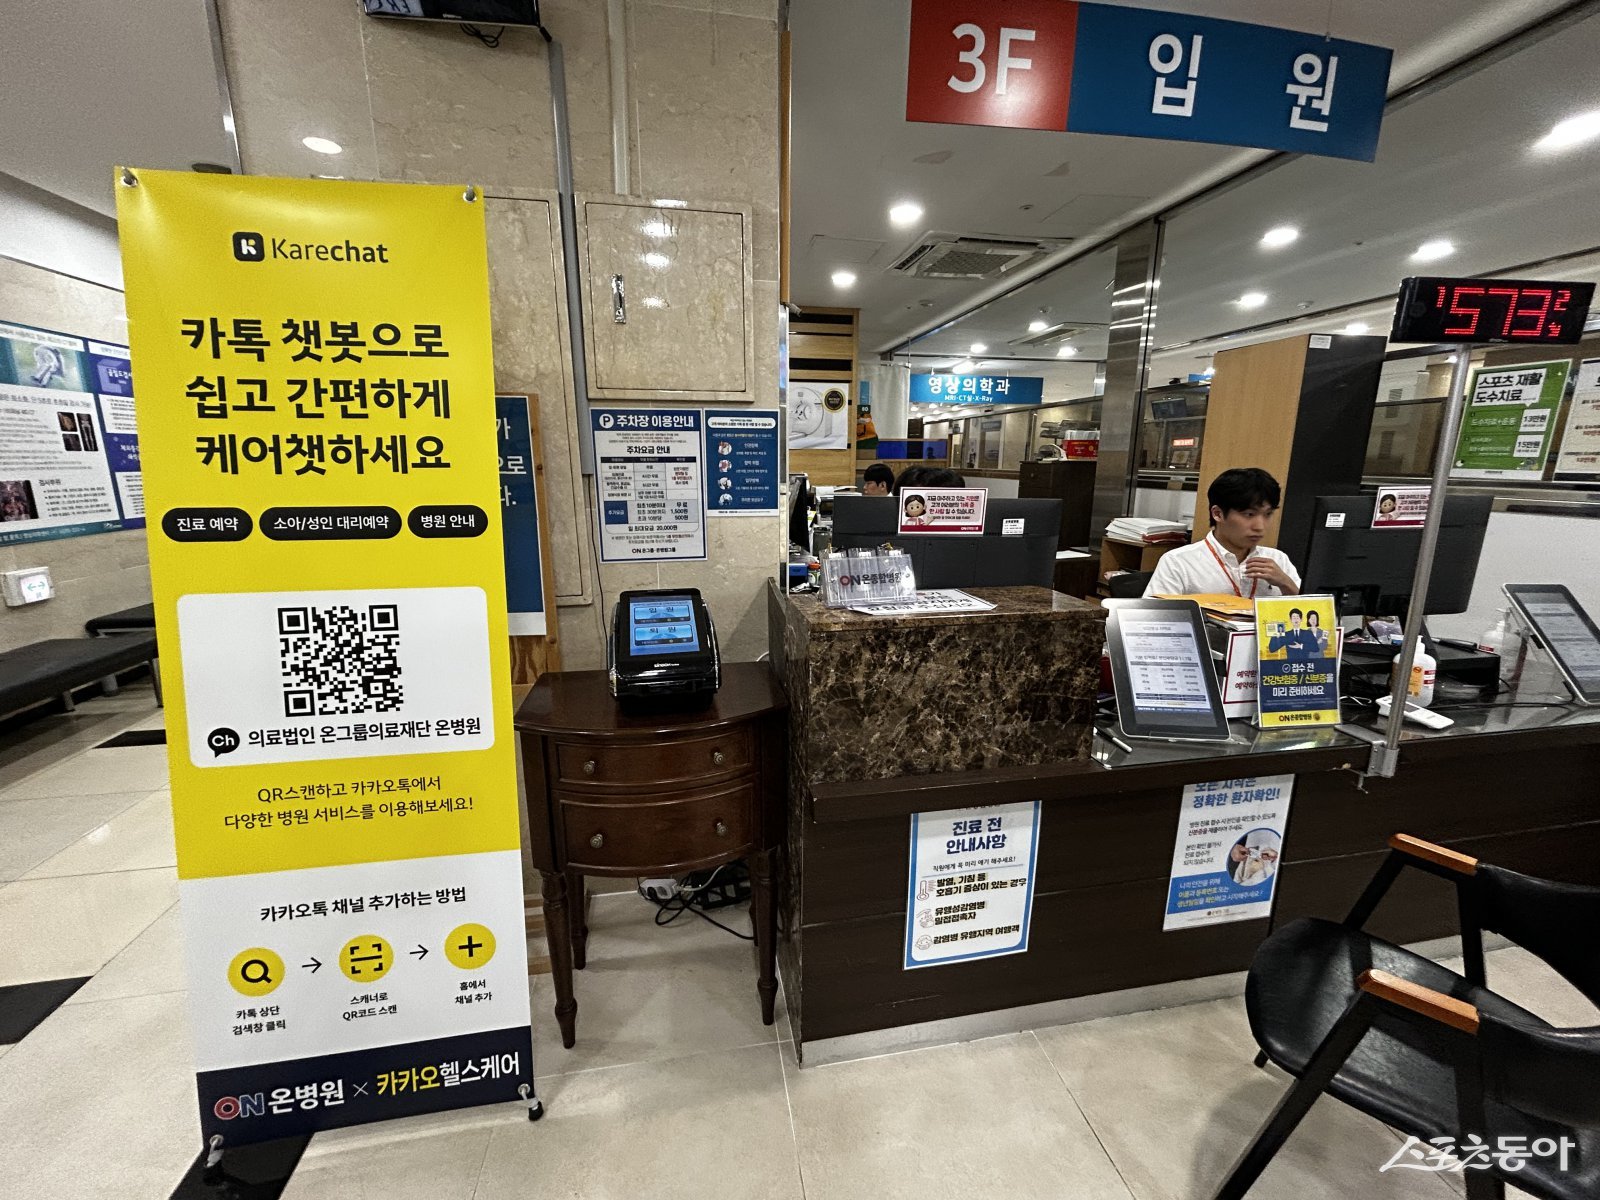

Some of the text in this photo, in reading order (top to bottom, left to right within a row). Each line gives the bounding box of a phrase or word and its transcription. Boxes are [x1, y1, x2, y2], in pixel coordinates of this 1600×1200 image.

[947, 22, 1339, 133] 3F 입 원
[272, 238, 389, 263] Karechat
[181, 317, 450, 364] 카톡 챗봇으로
[928, 376, 1010, 395] 영상의학과
[1478, 372, 1543, 389] 스포츠 재활
[185, 376, 276, 419] 쉽고
[286, 377, 450, 419] 간편하게
[1474, 389, 1523, 404] 도수치료
[616, 415, 649, 427] 주차장
[651, 415, 694, 428] 이용안내
[1523, 415, 1547, 423] 13만원
[626, 446, 671, 454] 주차요금 안내
[1517, 441, 1541, 449] 15만원
[195, 433, 451, 476] 케어챗하세요
[176, 514, 475, 532] 진료 예약 소아/성인 대리예약 병원 안내
[839, 572, 903, 586] ON 온종합병원
[1292, 663, 1315, 673] 접수 전
[1262, 675, 1298, 686] 건강보험증
[1305, 673, 1334, 684] 신분증을
[1273, 685, 1325, 697] 미리 준비하세요
[1279, 714, 1290, 722] ON
[211, 733, 235, 747] Ch
[248, 717, 482, 748] 의료법인 온그룹의료재단 온병원
[257, 775, 442, 803] QR스캔하고 카카오톡에서
[1192, 788, 1280, 809] 정확한 환자확인!
[224, 797, 474, 830] 다양한 병원 서비스를 이용해보세요!
[952, 817, 1002, 837] 진료 전
[946, 834, 1007, 855] 안내사항
[933, 863, 956, 872] 직원에게
[964, 860, 977, 868] 미리
[991, 856, 1016, 866] 해주세요!
[936, 873, 986, 888] 발열, 기침 등
[936, 877, 1027, 898] 호흡기 증상이 있는 경우
[260, 886, 466, 923] 카카오톡 채널 추가하는 방법
[935, 901, 986, 916] 유행성감염병
[934, 912, 977, 926] 밀접접촉자
[934, 924, 1020, 945] 감염병 유행지역 여행객
[459, 979, 487, 991] 홈에서
[350, 992, 389, 1005] 스캐너로
[454, 991, 493, 1005] 채널 추가
[236, 1005, 280, 1020] 카톡 상단
[342, 1004, 398, 1021] QR코드 스캔
[232, 1019, 286, 1036] 검색창 클릭
[213, 1052, 520, 1120] ON 온병원 카카오헬스케어
